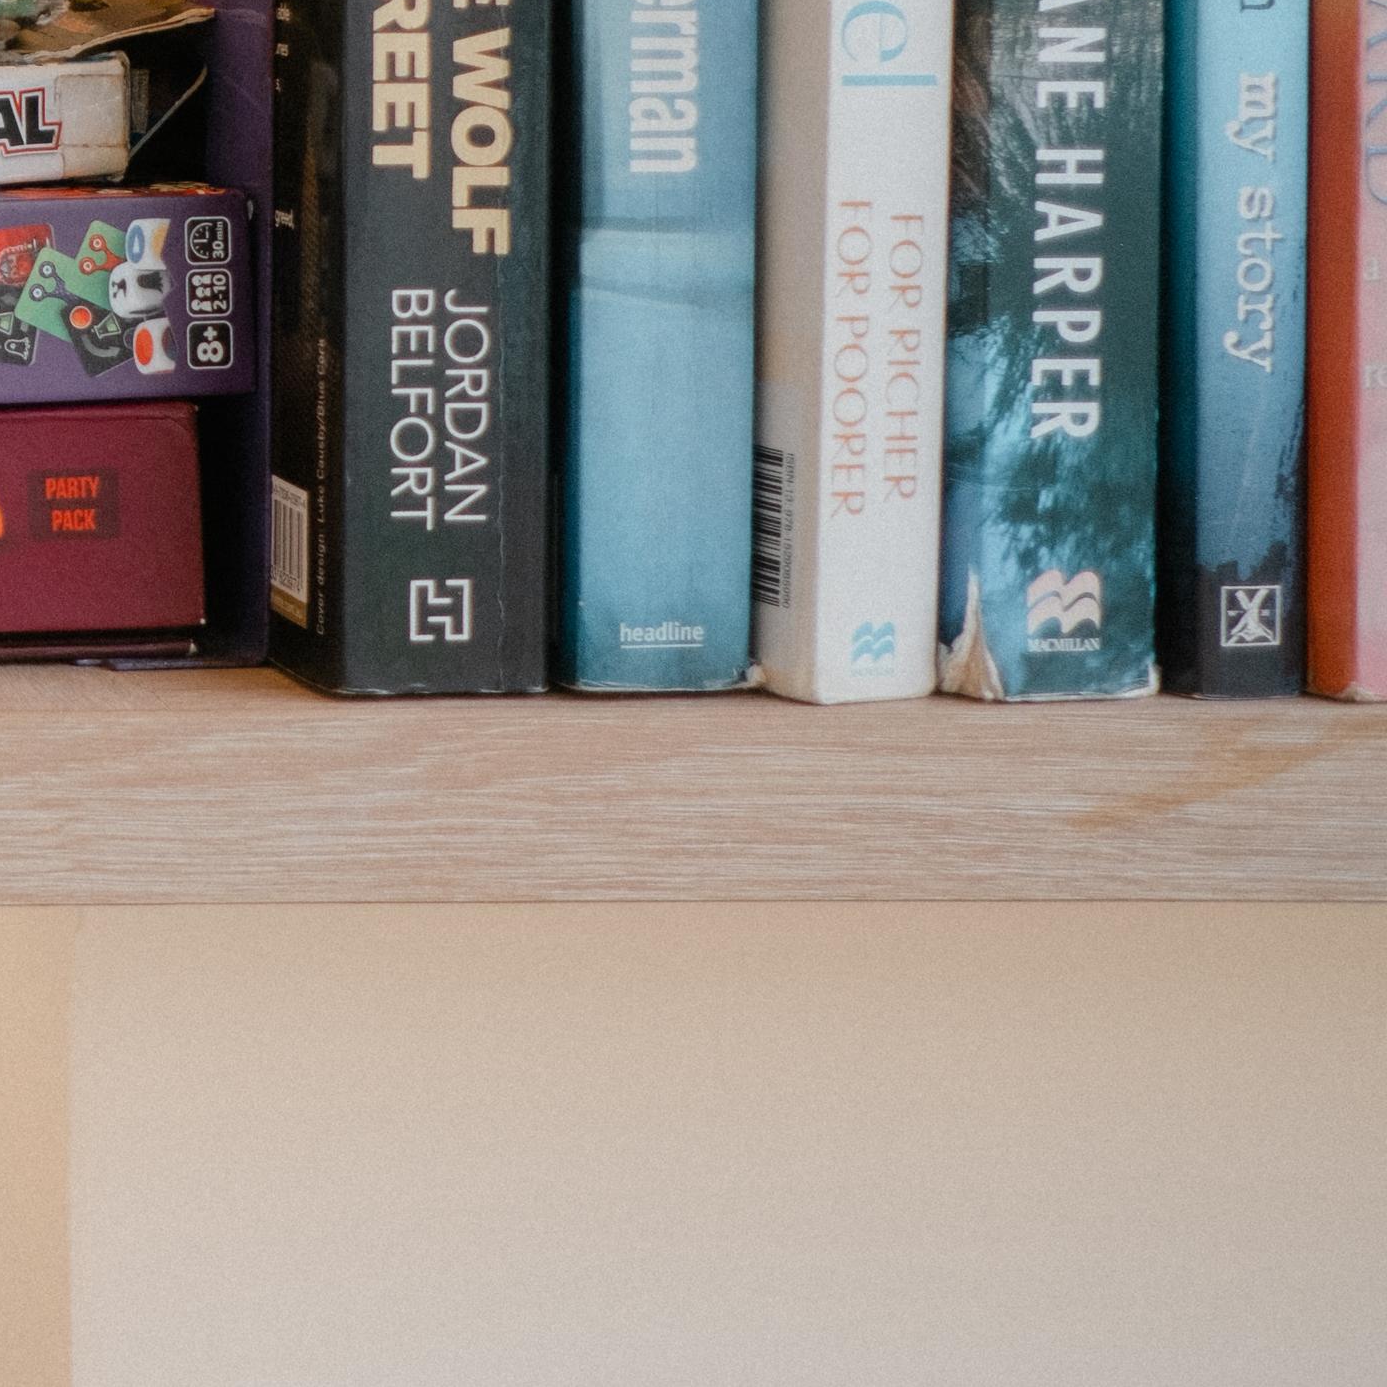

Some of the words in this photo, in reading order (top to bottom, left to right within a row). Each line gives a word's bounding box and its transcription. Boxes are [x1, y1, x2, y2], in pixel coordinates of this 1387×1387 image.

[451, 27, 514, 256] WOLF
[1225, 71, 1277, 163] my
[212, 273, 227, 310] 2-10
[835, 199, 873, 299] FOR
[887, 213, 925, 314] FOR
[1029, 147, 1105, 440] HARPER
[1224, 185, 1284, 374] story
[196, 325, 225, 363] 8+
[390, 288, 436, 531] BELFORT
[443, 287, 490, 522] JORDAN
[830, 314, 870, 520] POORER
[883, 328, 922, 503] RICHER
[45, 475, 100, 500] PARTY
[51, 508, 96, 532] PACK
[317, 485, 326, 524] Luke
[316, 593, 326, 635] Cover
[620, 620, 705, 642] headline
[1027, 638, 1101, 653] MACMILLAN
